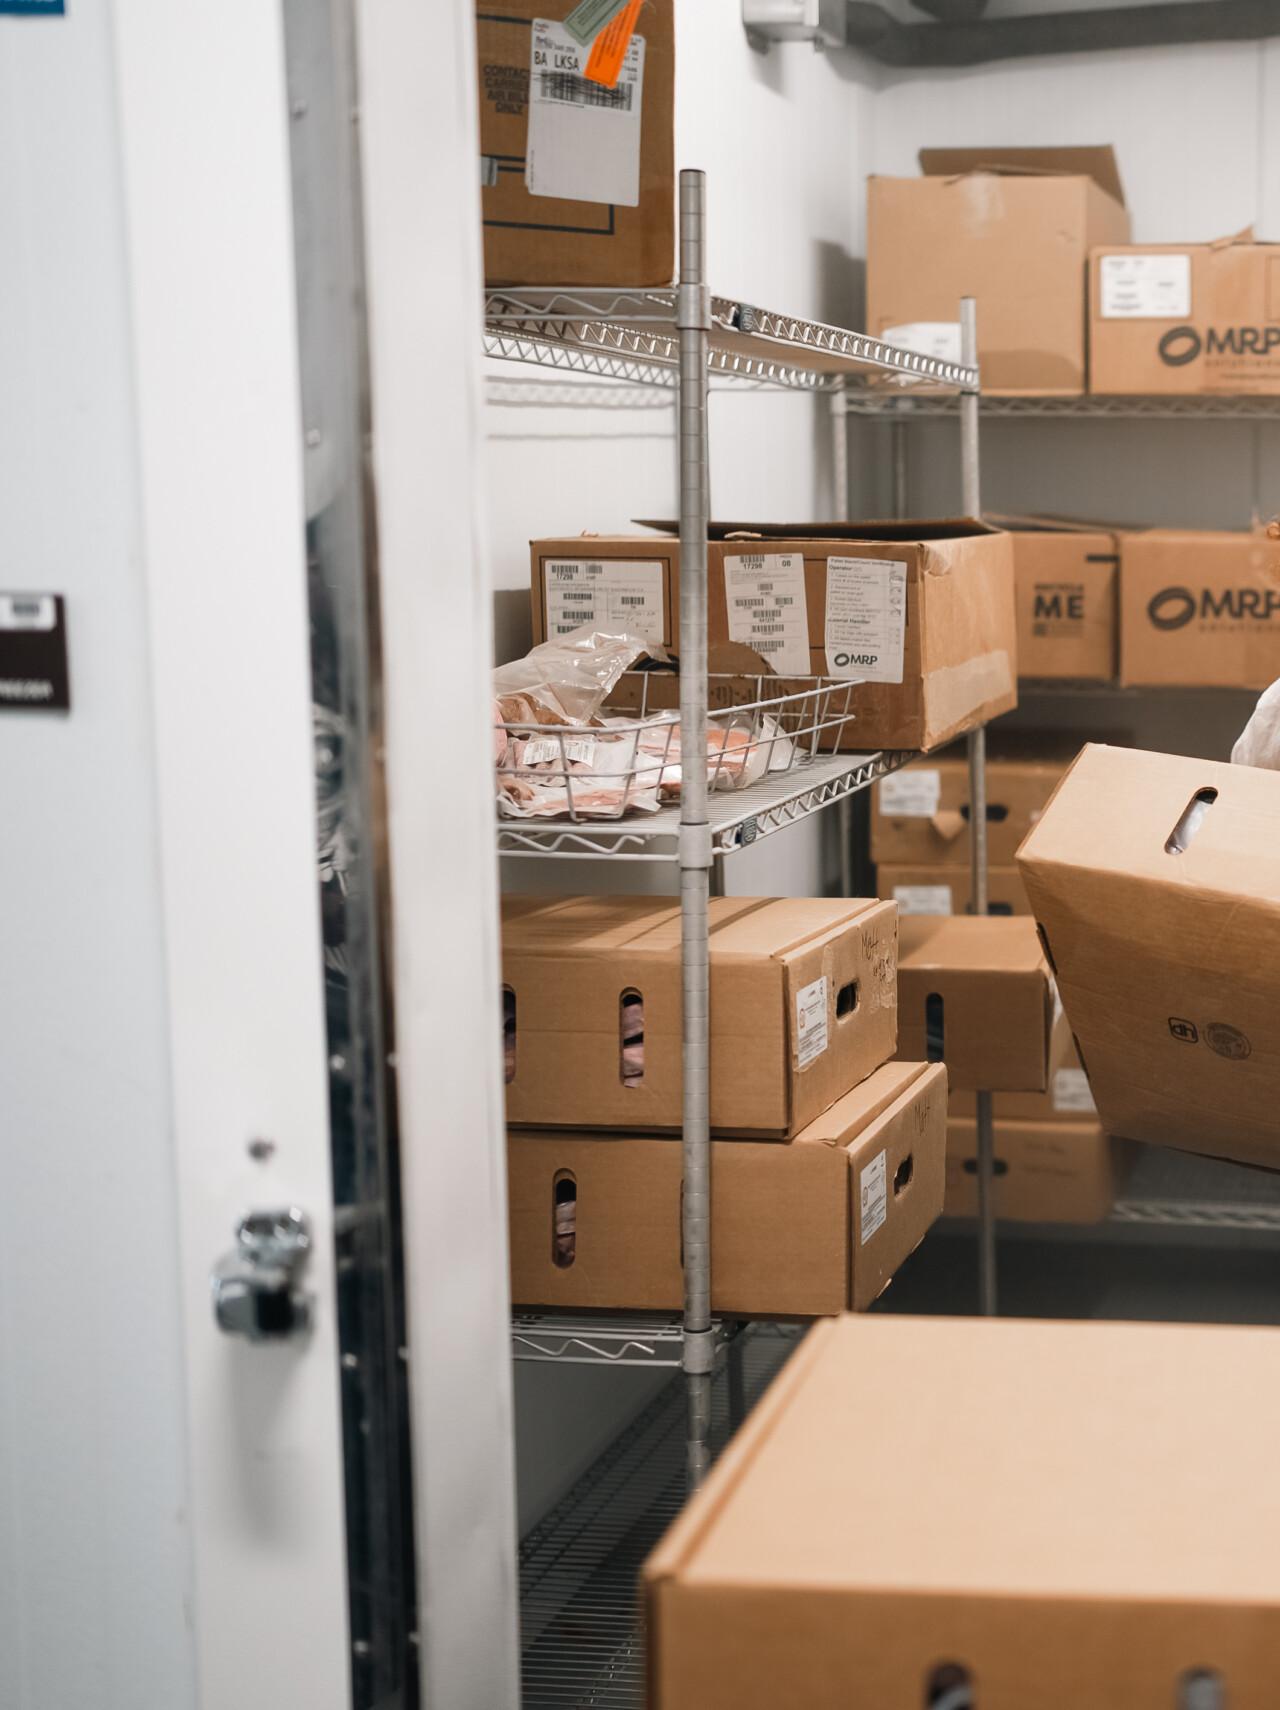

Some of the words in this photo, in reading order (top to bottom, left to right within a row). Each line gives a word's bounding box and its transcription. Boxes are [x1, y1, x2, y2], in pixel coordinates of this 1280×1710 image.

[534, 51, 548, 66] BA
[554, 54, 580, 71] LKSA
[1034, 595, 1084, 619] ME
[850, 653, 878, 665] MRP
